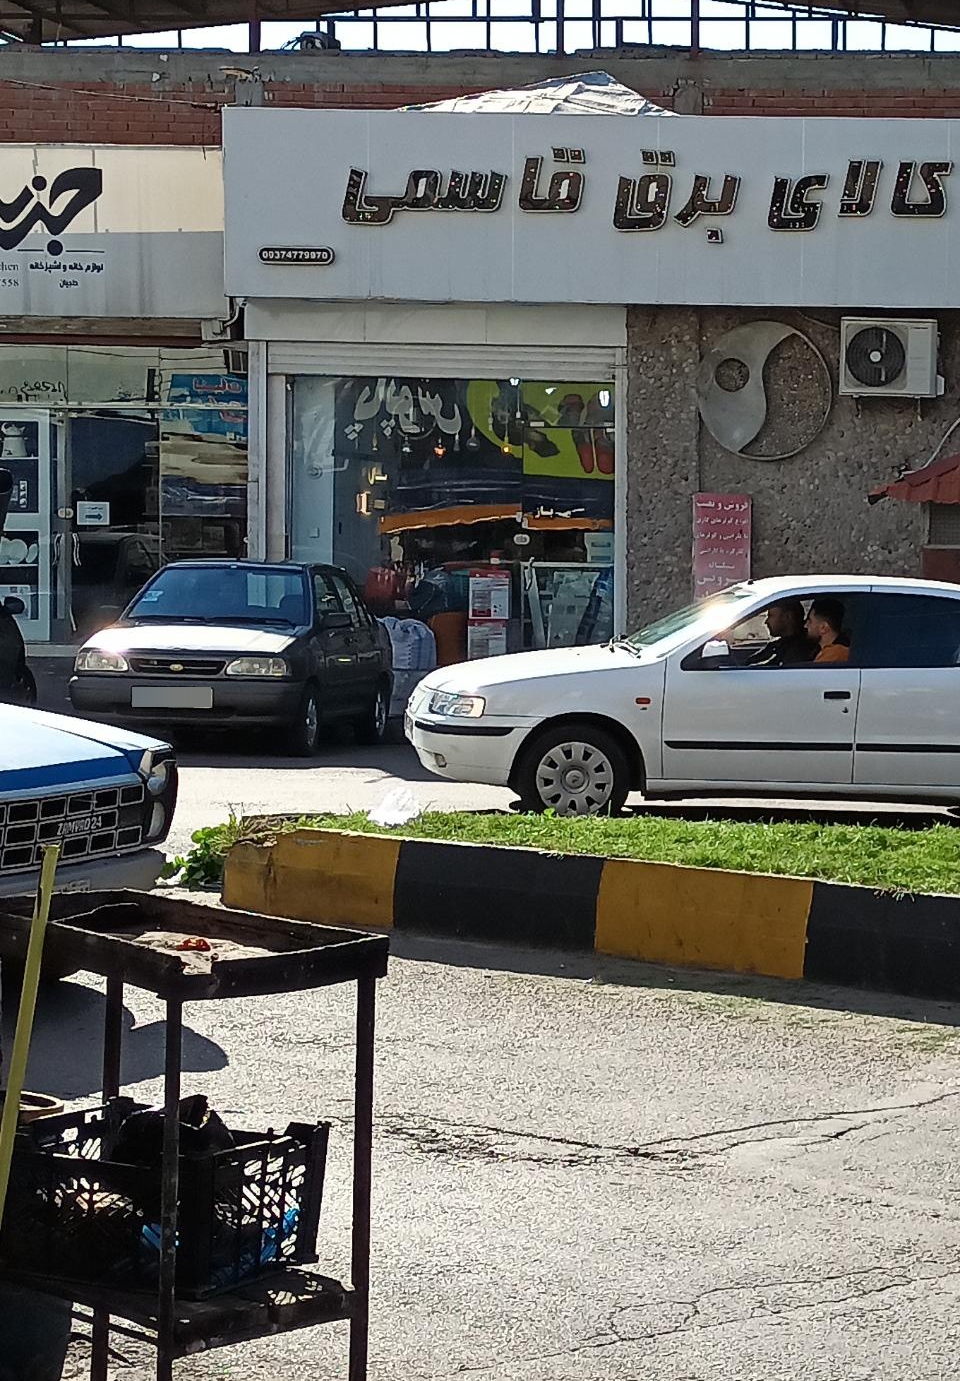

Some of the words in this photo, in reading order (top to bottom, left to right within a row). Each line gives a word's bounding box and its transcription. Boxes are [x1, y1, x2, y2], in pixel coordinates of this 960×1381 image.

[342, 146, 588, 225] قاسمی
[612, 148, 742, 244] برق
[767, 159, 955, 231] کالای
[68, 262, 84, 271] خانه
[85, 262, 104, 273] لوازم
